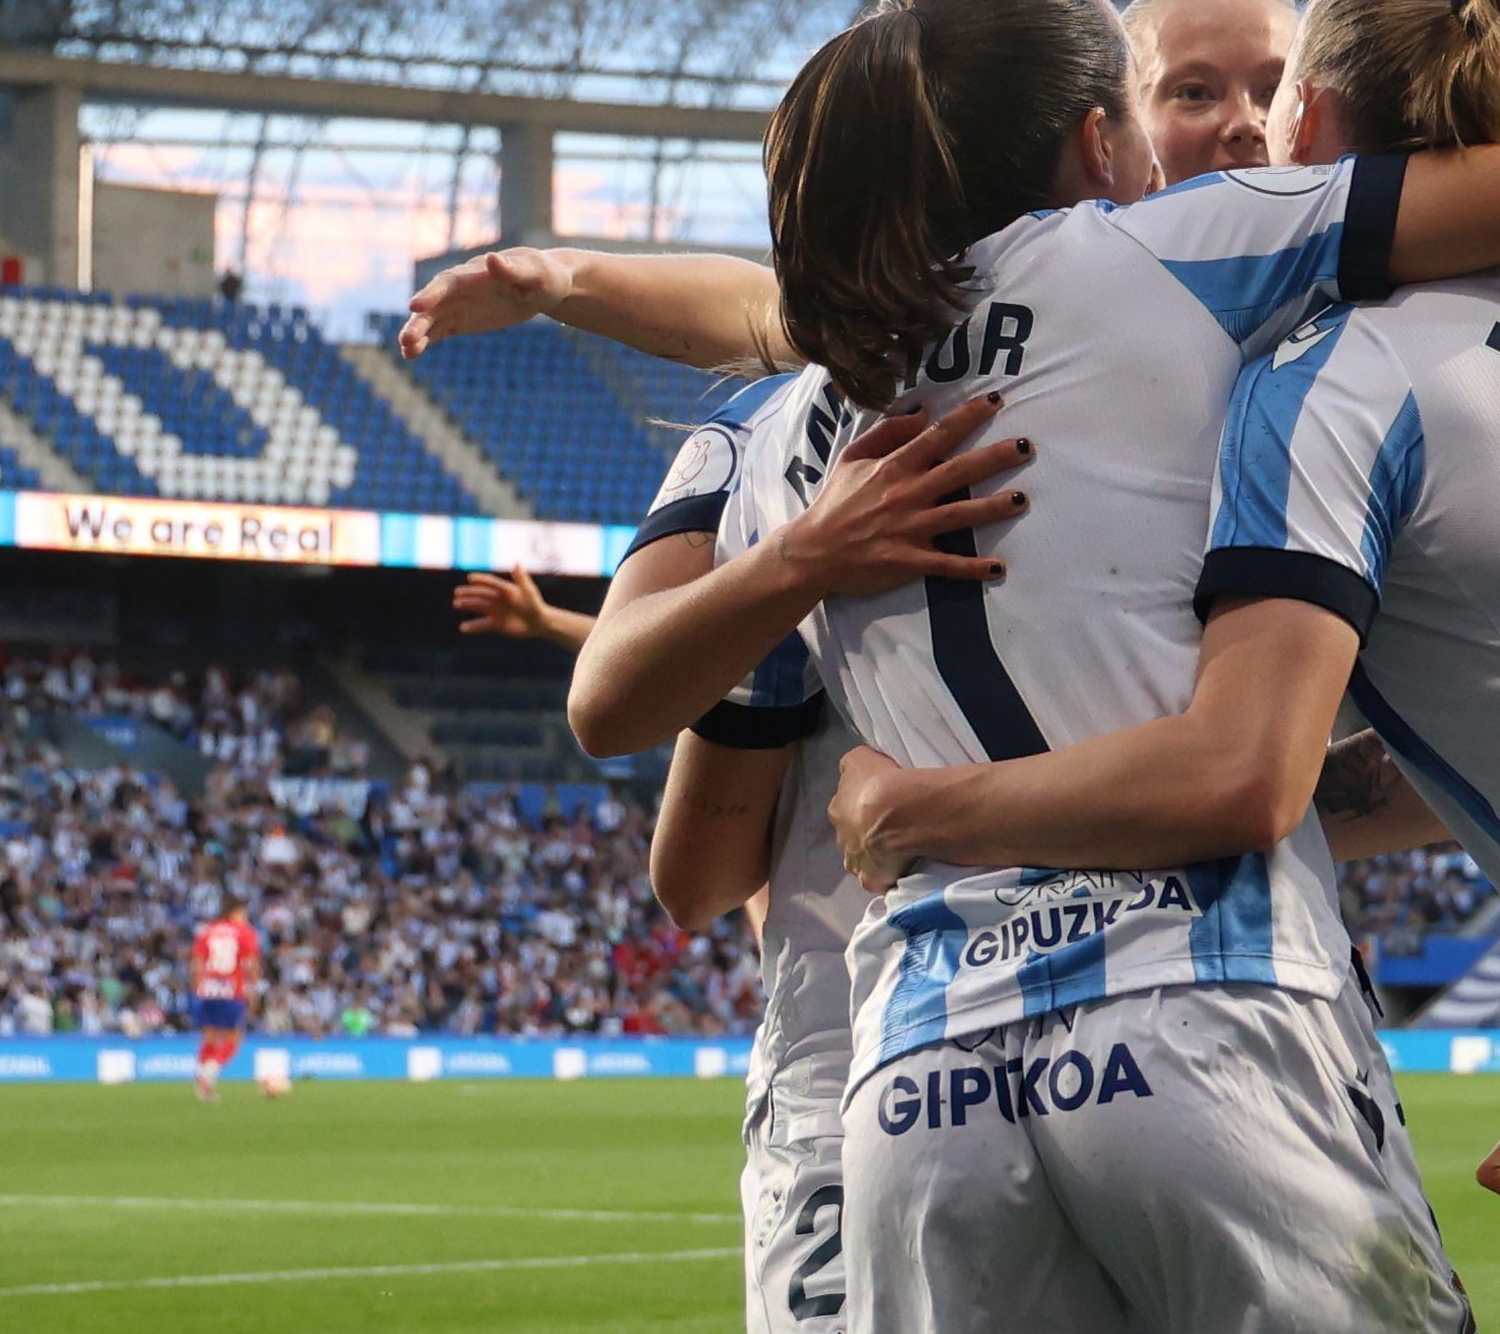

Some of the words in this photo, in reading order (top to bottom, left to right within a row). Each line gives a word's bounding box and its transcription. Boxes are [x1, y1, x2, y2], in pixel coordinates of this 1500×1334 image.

[63, 503, 133, 541] We
[150, 517, 224, 546] are
[240, 515, 334, 553] Real
